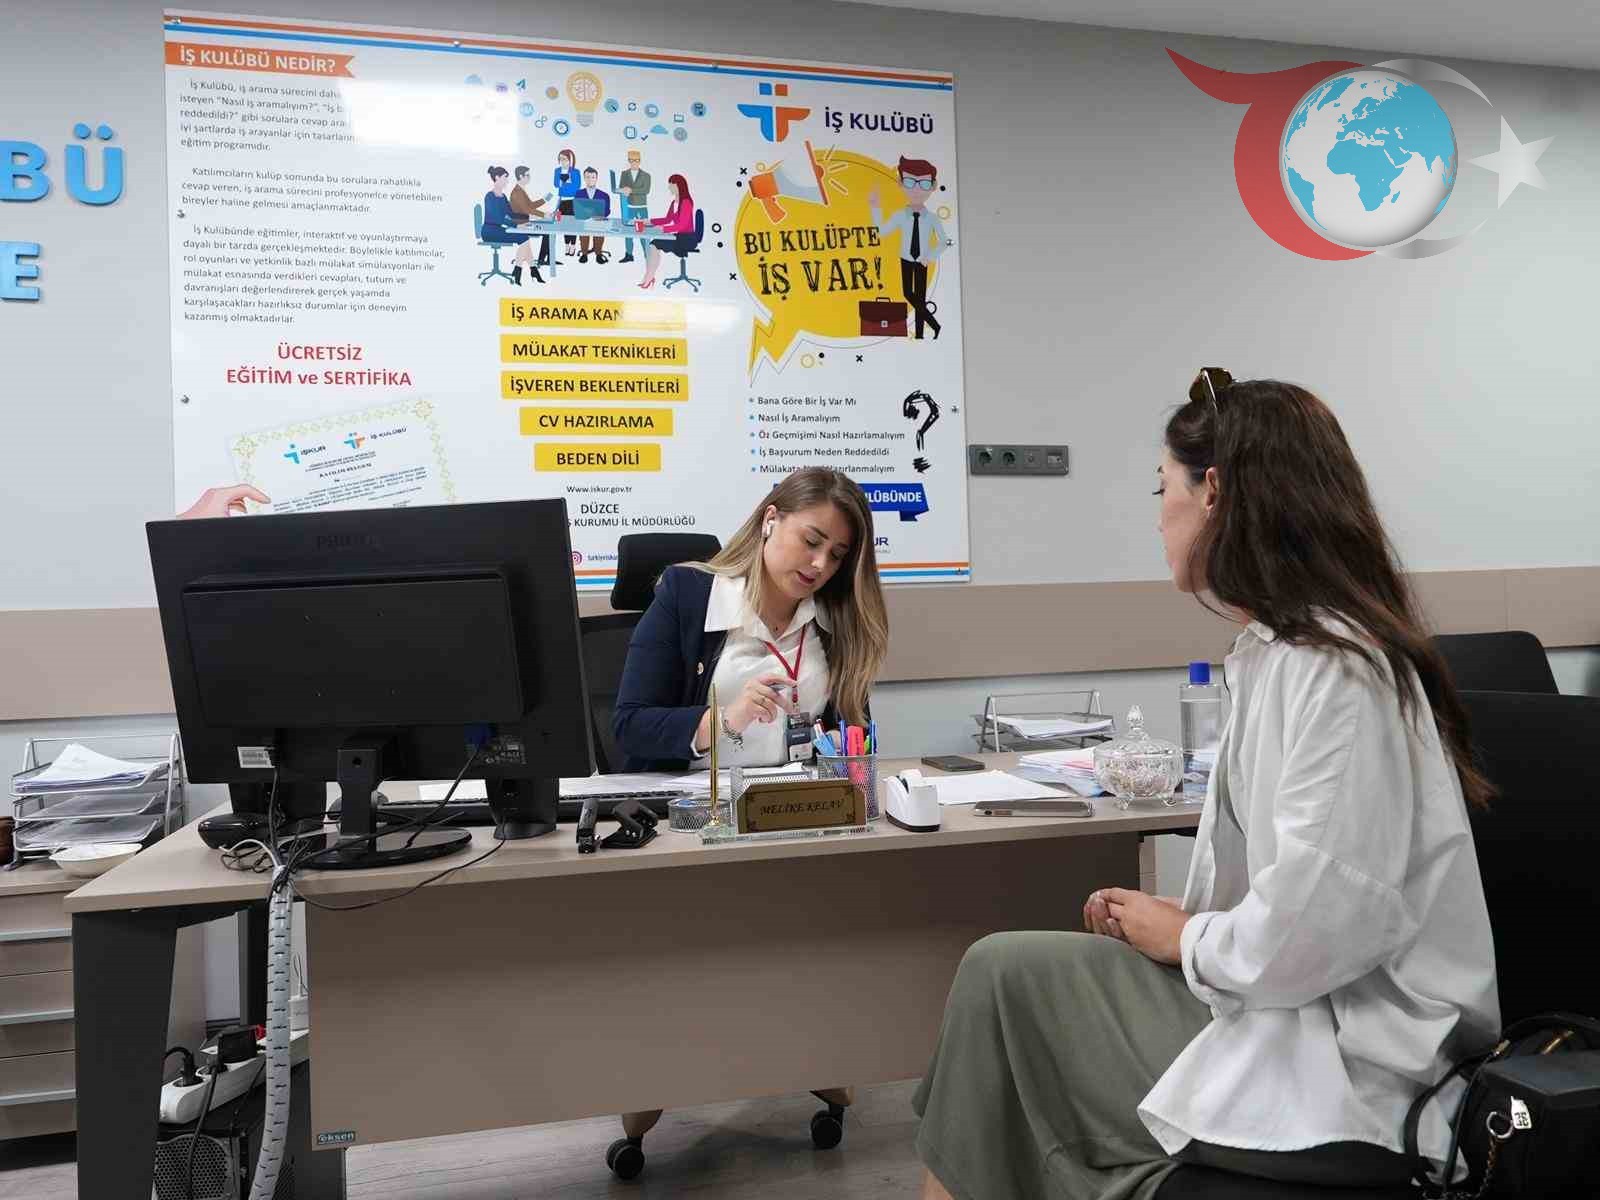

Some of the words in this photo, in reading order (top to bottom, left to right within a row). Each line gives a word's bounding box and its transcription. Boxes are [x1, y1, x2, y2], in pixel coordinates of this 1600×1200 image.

[180, 46, 196, 65] İŞ
[201, 50, 270, 68] KULÜBÜ
[276, 55, 336, 72] NEDİR?
[248, 86, 278, 95] arama
[280, 87, 317, 97] sürecini
[261, 114, 299, 125] sorulara
[301, 118, 328, 128] cevap
[824, 106, 844, 134] İŞ
[850, 112, 934, 135] KULÜBÜ
[194, 125, 236, 136] şartlarda
[248, 128, 291, 140] arayanlar
[294, 130, 311, 141] için
[181, 137, 212, 148] eğitim
[192, 167, 254, 179] Katılımcıların
[256, 170, 282, 182] kulüp
[284, 173, 324, 184] sonunda
[326, 174, 338, 184] bu
[342, 176, 378, 185] sorulara
[380, 177, 422, 187] rahatlıkla
[182, 182, 210, 192] cevap
[286, 186, 322, 196] sürecini
[324, 189, 388, 200] profesyonelce
[390, 192, 443, 202] yönetebilen
[182, 195, 218, 206] bireyler
[222, 197, 250, 206] haline
[252, 199, 288, 209] gelmesi
[204, 226, 256, 236] Kulübünde
[304, 231, 345, 240] interaktif
[360, 233, 428, 244] oyunlaştırmaya
[744, 231, 772, 254] BU
[781, 224, 881, 252] KULÜPTE
[214, 240, 227, 249] bir
[230, 242, 258, 250] tarzda
[184, 254, 196, 263] rol
[199, 256, 238, 266] oyunları
[295, 258, 316, 267] bazlı
[318, 260, 356, 269] mülakat
[358, 260, 422, 272] simülasyonları
[184, 269, 222, 278] mülakat
[224, 271, 272, 280] esnasında
[274, 272, 318, 281] verdikleri
[366, 275, 394, 284] tutum
[758, 255, 792, 301] İŞ
[800, 255, 885, 292] VAR!
[184, 283, 239, 294] davranışları
[241, 284, 316, 296] değerlendirerek
[318, 287, 348, 298] gerçek
[350, 290, 391, 298] yaşamda
[184, 297, 256, 308] karşılaşacakları
[304, 301, 348, 310] durumlar
[350, 303, 366, 313] için
[368, 304, 408, 313] deneyim
[184, 312, 229, 323] kazanmış
[511, 304, 525, 322] İŞ
[529, 306, 588, 321] ARAMA
[277, 342, 362, 361] ÜCRETSİZ
[512, 341, 588, 358] MÜLAKAT
[592, 344, 676, 360] TEKNİKLERİ
[226, 365, 292, 385] EĞİTİM
[297, 372, 318, 385] ve
[323, 368, 412, 387] SERTİFİKA
[510, 376, 574, 395] İŞVEREN
[580, 378, 680, 394] BEKLENTİLERİ
[758, 396, 780, 406] Bana
[782, 396, 803, 407] Göre
[804, 397, 817, 406] Bir
[820, 396, 827, 408] İş
[829, 398, 843, 406] Var
[844, 398, 857, 406] Mı
[538, 415, 559, 428] CV
[564, 415, 655, 428] HAZIRLAMA
[758, 414, 780, 423] Nasıl
[782, 412, 790, 424] İş
[791, 414, 840, 424] Aramalıyım
[772, 430, 818, 442] Geçmişimi
[820, 430, 841, 440] Nasıl
[842, 430, 905, 442] Hazırlamalıyım
[556, 452, 608, 466] BEDEN
[612, 450, 640, 465] DİLİ
[758, 446, 766, 458] İş
[768, 448, 812, 458] Başvurum
[814, 448, 842, 456] Neden
[844, 448, 890, 456] Reddedildi
[865, 490, 922, 502] LÜBÜNDE
[580, 502, 620, 514] DÜZCE
[574, 518, 619, 527] KURUMU
[621, 516, 630, 526] İL
[632, 515, 696, 526] MÜDÜRLÜĞÜ
